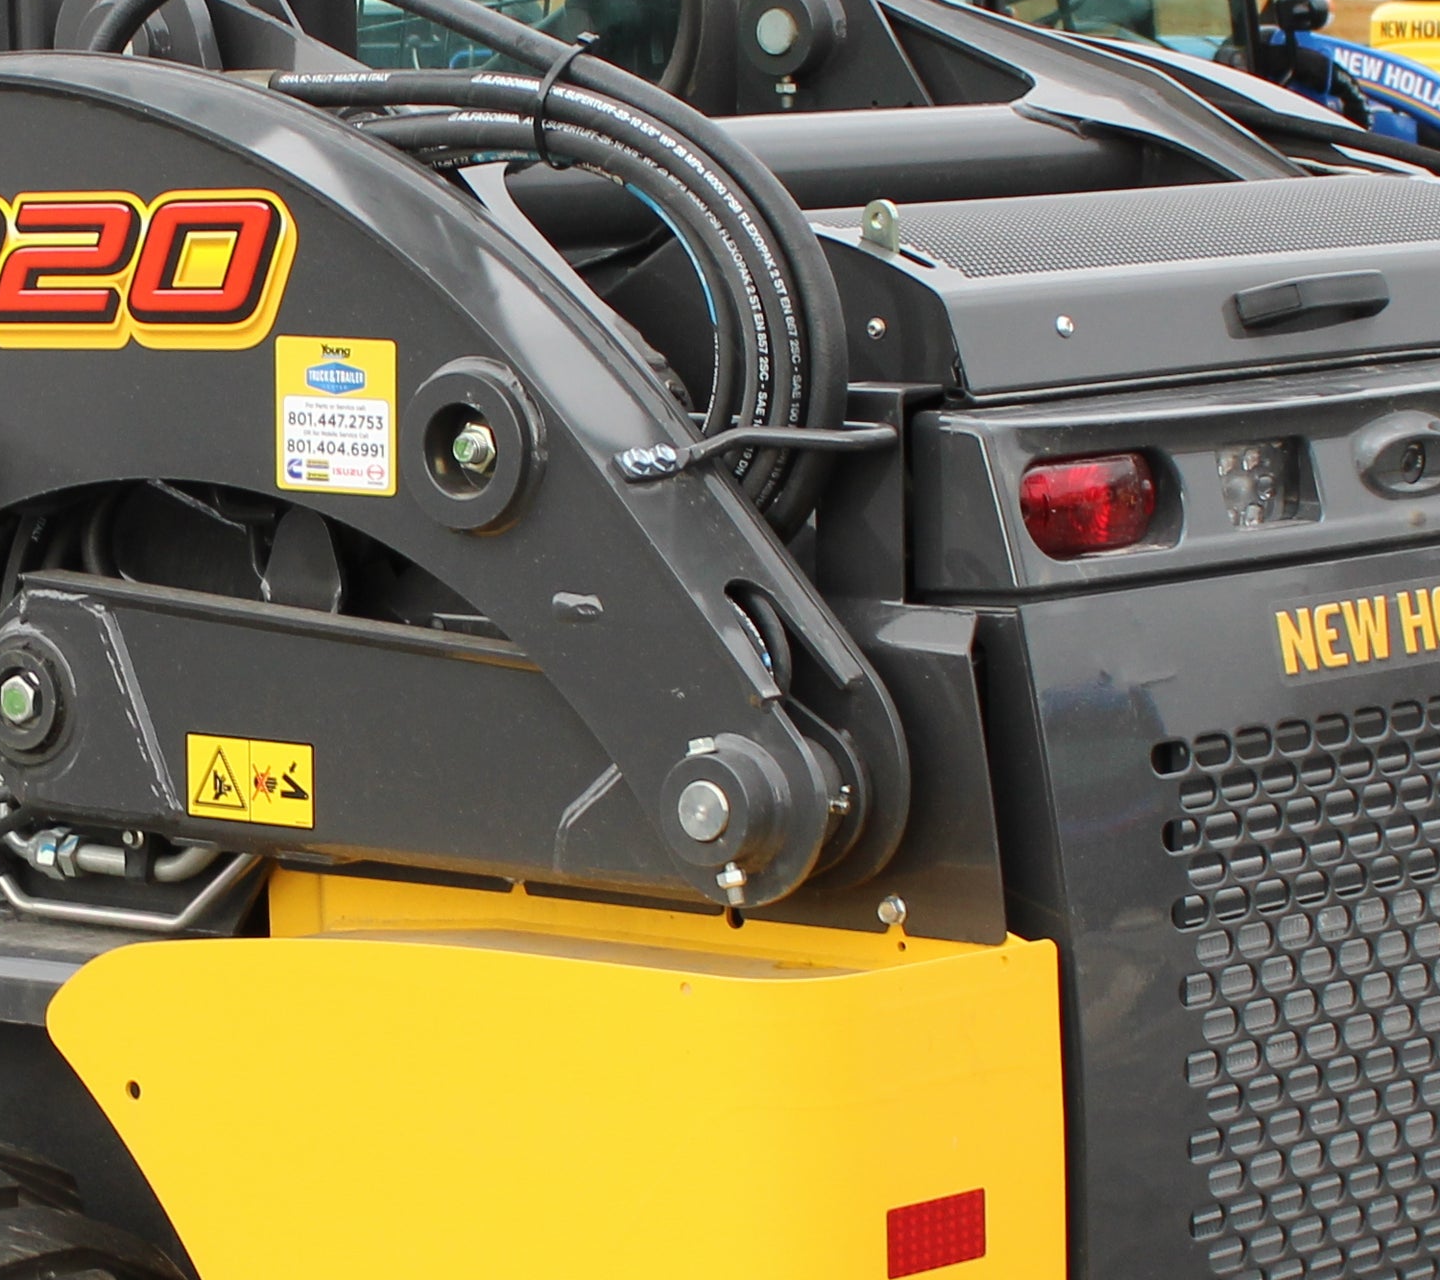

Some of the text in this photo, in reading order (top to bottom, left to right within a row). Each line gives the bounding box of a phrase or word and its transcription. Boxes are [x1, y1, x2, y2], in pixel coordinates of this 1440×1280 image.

[1380, 20, 1408, 38] NEW
[1334, 47, 1383, 81] NEW
[458, 111, 519, 124] ALFAGOMMA
[659, 134, 676, 148] WP
[684, 154, 705, 174] MPa
[738, 211, 776, 270] FLEXOPAK
[718, 227, 753, 286] FLEXOPAK
[770, 268, 780, 279] 2
[745, 284, 756, 296] 2
[774, 278, 787, 295] ST
[749, 294, 762, 311] ST
[780, 296, 793, 315] EN
[753, 313, 765, 331] EN
[321, 343, 351, 359] Young
[757, 333, 768, 354] 857
[789, 339, 801, 364] 2SC
[758, 356, 770, 382] 2SC
[791, 375, 802, 399] SAE
[755, 391, 768, 416] SAE
[789, 403, 800, 422] 100
[288, 411, 384, 431] 801.447.2753
[287, 438, 385, 458] 801.404.6991
[333, 467, 363, 477] ISUZU
[1276, 593, 1390, 677] NEW
